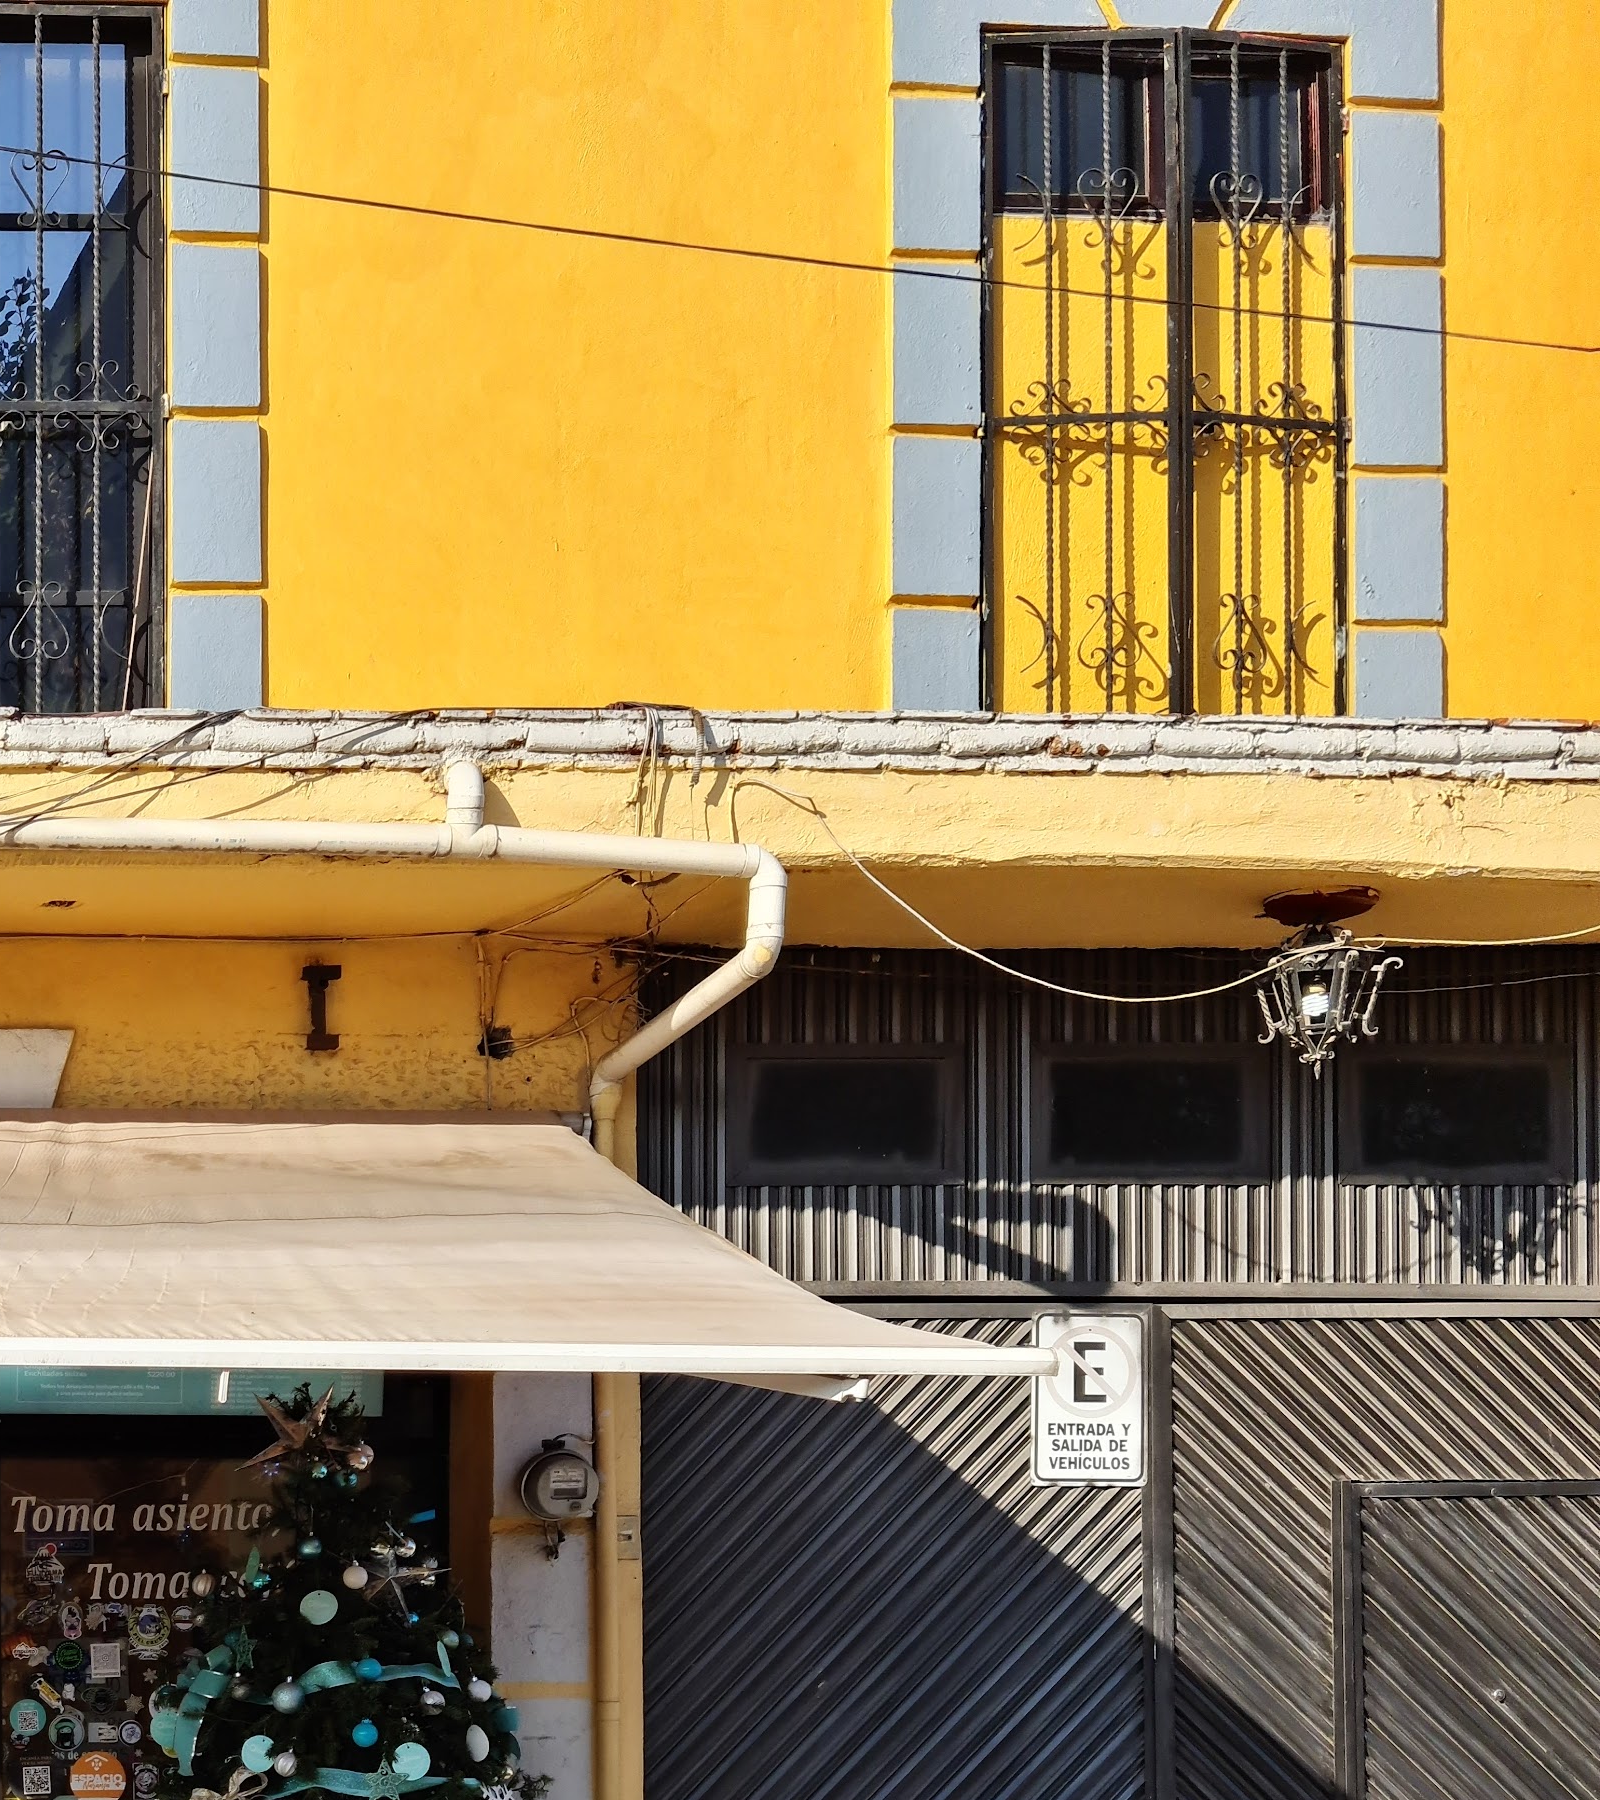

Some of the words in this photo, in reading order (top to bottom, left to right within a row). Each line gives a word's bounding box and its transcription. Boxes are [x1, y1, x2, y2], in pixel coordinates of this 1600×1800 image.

[1074, 1341, 1107, 1403] E
[1047, 1422, 1116, 1436] ENTRADA
[1121, 1423, 1132, 1436] Y
[1051, 1439, 1104, 1452] SALIDA
[1108, 1439, 1129, 1452] DE
[1048, 1452, 1131, 1470] VEHÍCULOS
[11, 1496, 115, 1533] Toma
[71, 1773, 123, 1783] ESPACIO
